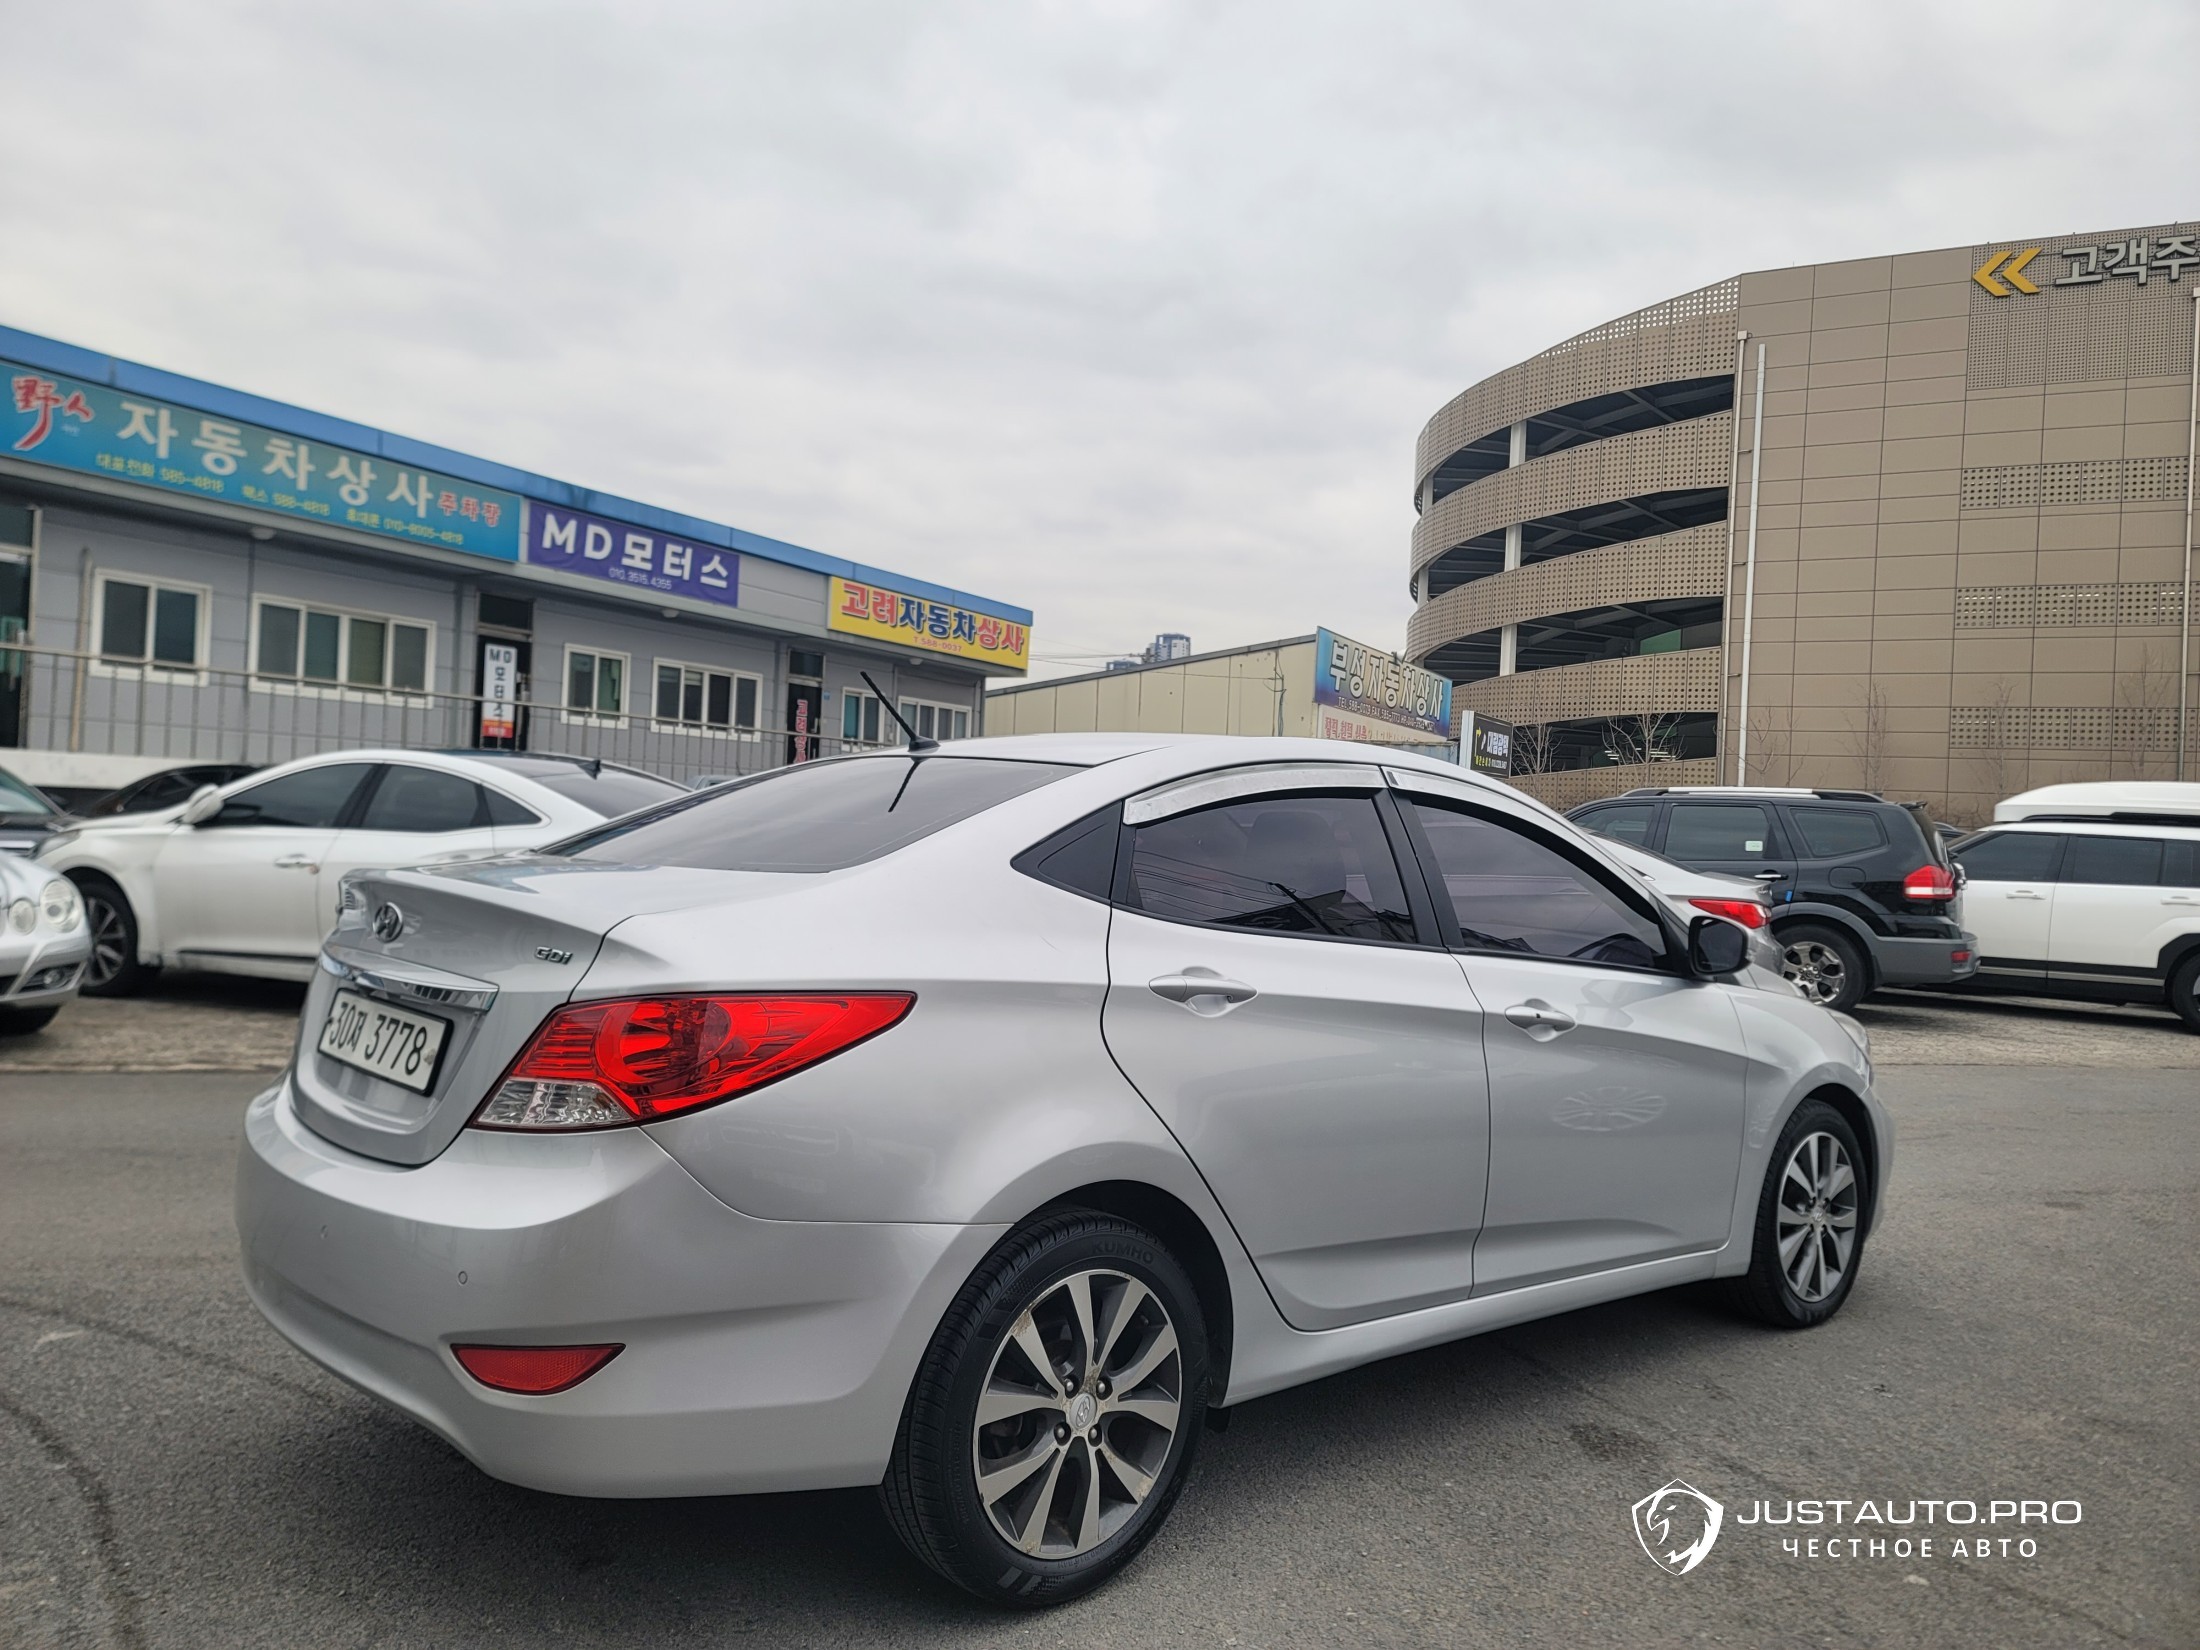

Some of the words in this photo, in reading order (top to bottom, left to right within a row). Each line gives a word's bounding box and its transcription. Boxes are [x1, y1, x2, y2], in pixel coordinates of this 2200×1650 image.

[2055, 235, 2200, 286] 고객주
[116, 401, 434, 518] 자동차상사
[841, 582, 1026, 655] 고려자동차상사
[1329, 639, 1443, 721] 부성자동차상사
[364, 1013, 427, 1076] 3778
[1091, 1239, 1154, 1264] KUMHO
